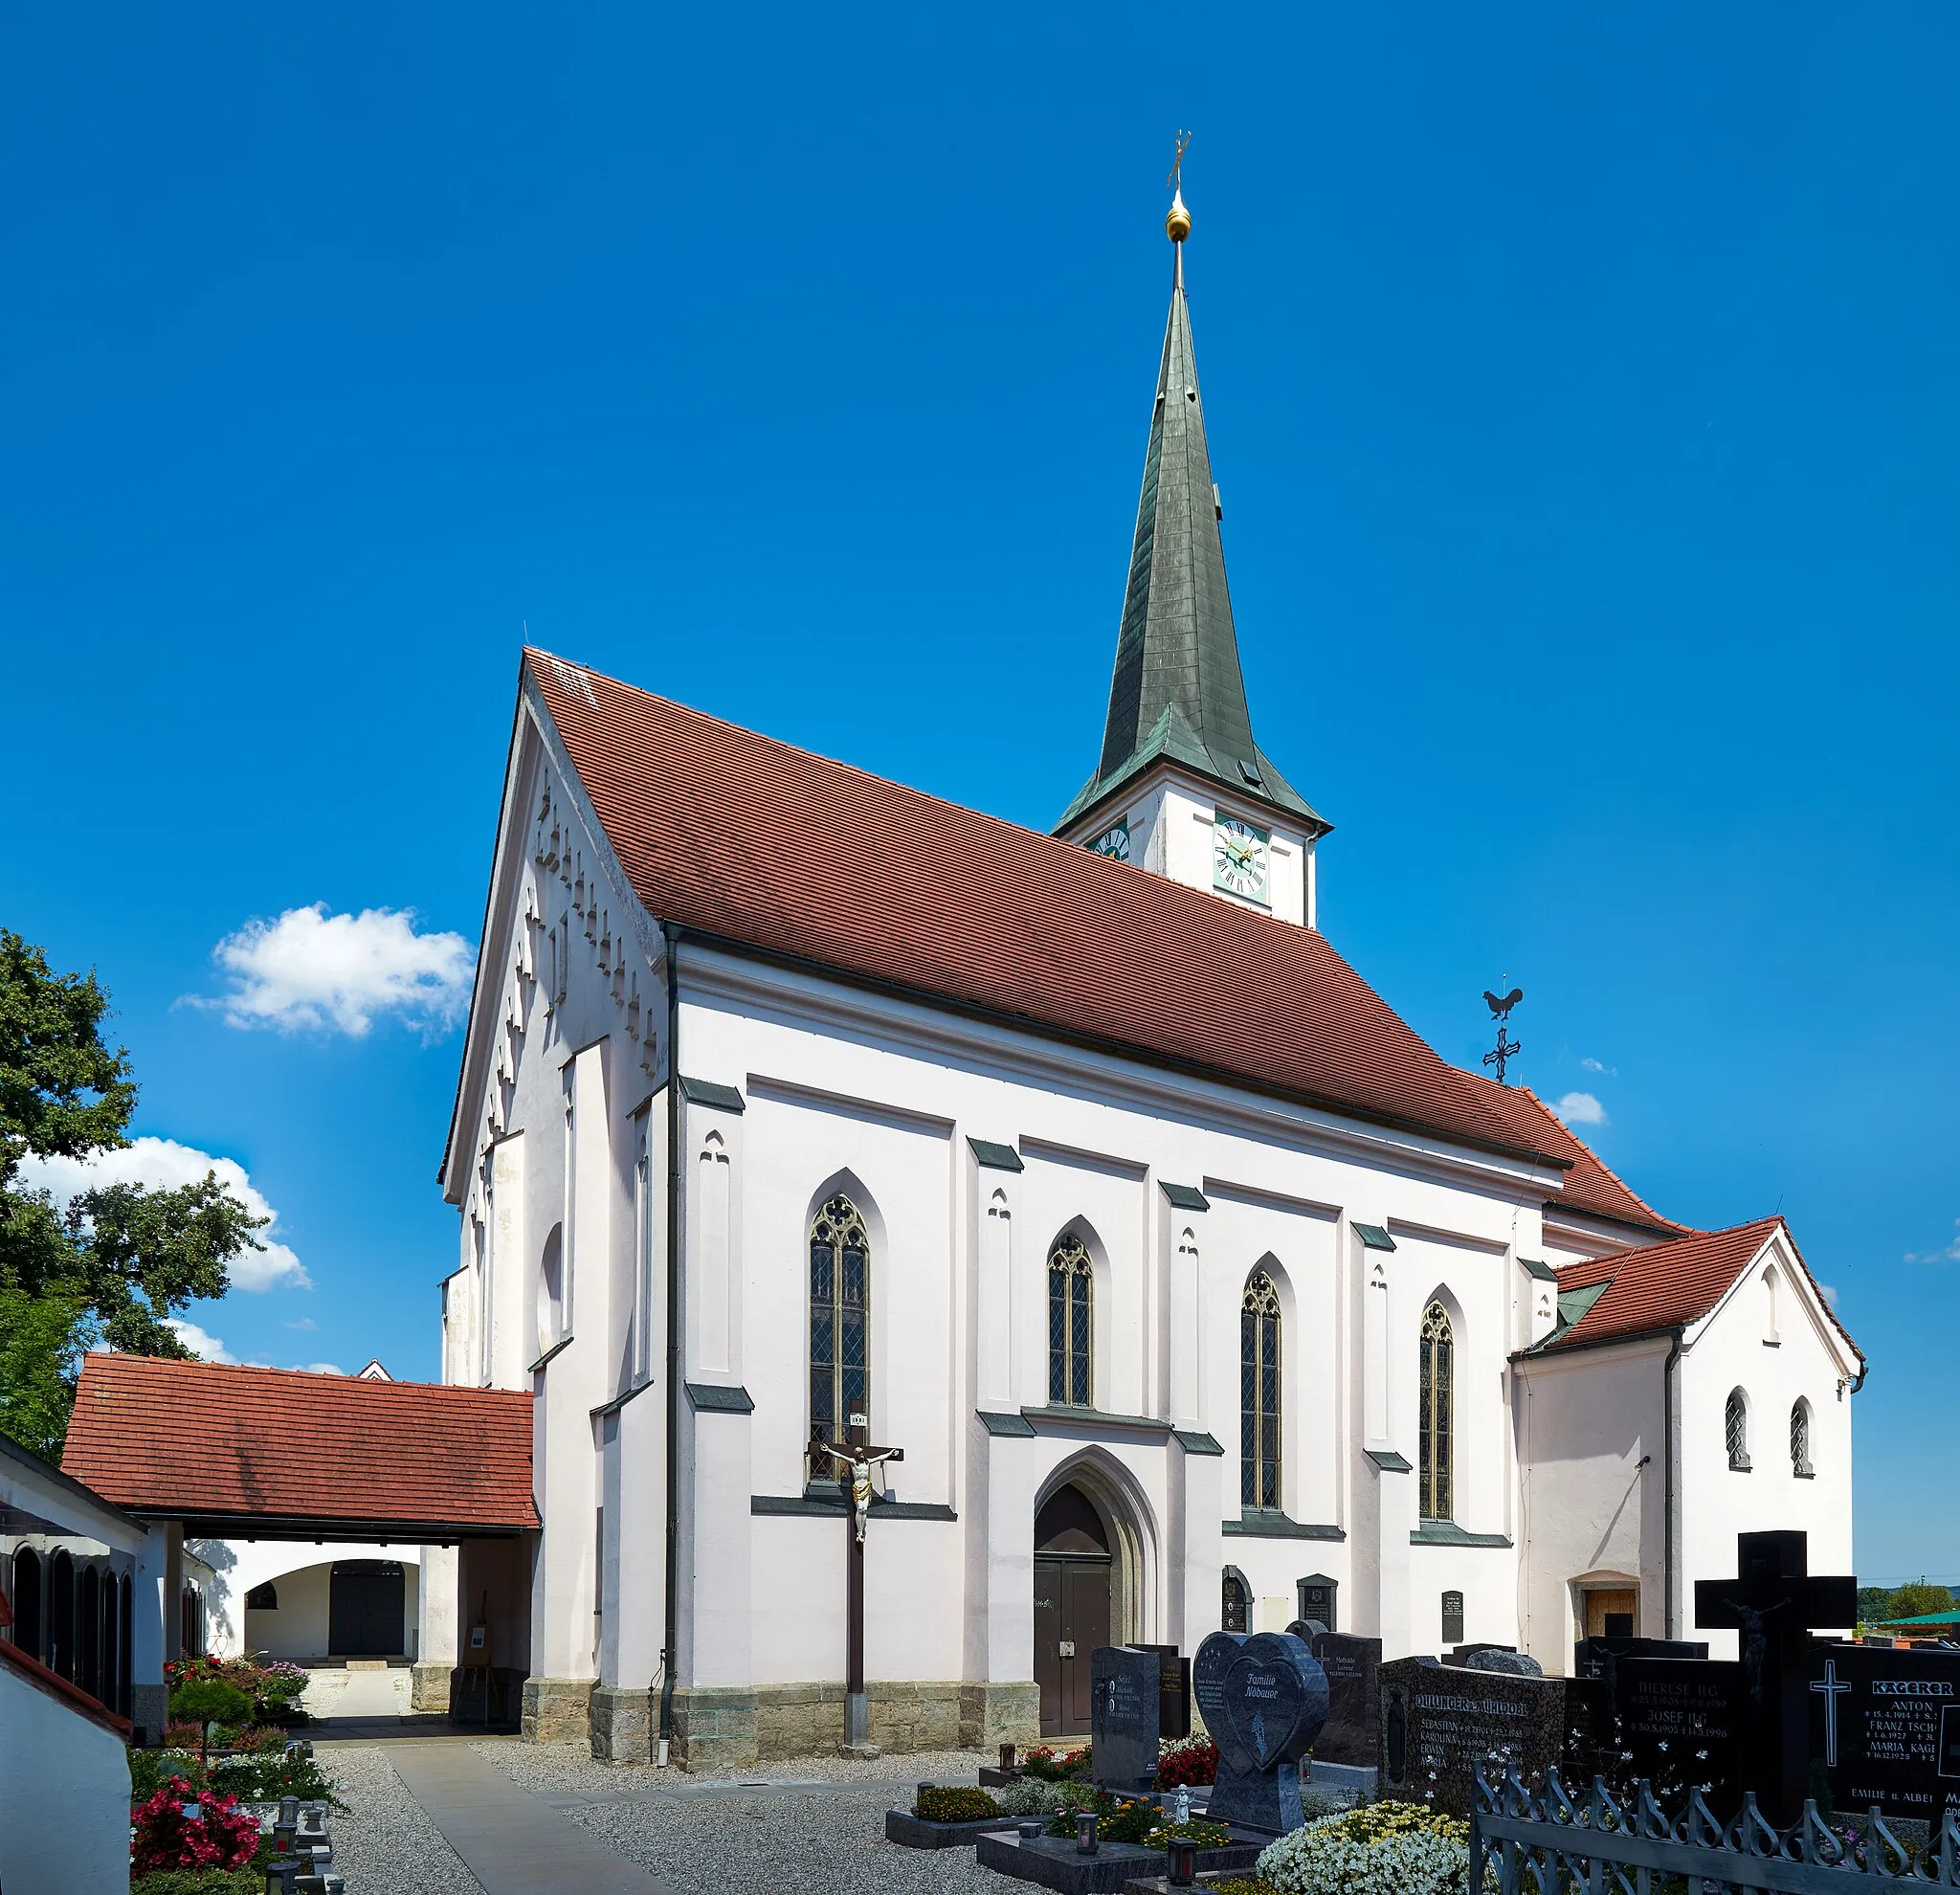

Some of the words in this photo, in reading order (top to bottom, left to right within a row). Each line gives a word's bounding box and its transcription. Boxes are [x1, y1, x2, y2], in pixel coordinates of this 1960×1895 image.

[1247, 1673, 1277, 1687] Familie
[1244, 1685, 1279, 1701] Nöbauer
[1637, 1682, 1691, 1696] THERESE
[1892, 1701, 1933, 1711] ANTON
[1647, 1709, 1684, 1724] JOSEF
[1420, 1719, 1459, 1731] SEBASTIAN
[1870, 1720, 1904, 1731] FRANZ
[1907, 1722, 1937, 1732] TSCH
[1420, 1731, 1458, 1745] KAROLINA
[1420, 1743, 1445, 1755] ERWIN
[1870, 1742, 1904, 1752] MARIA
[1852, 1788, 1885, 1799] EMILIE
